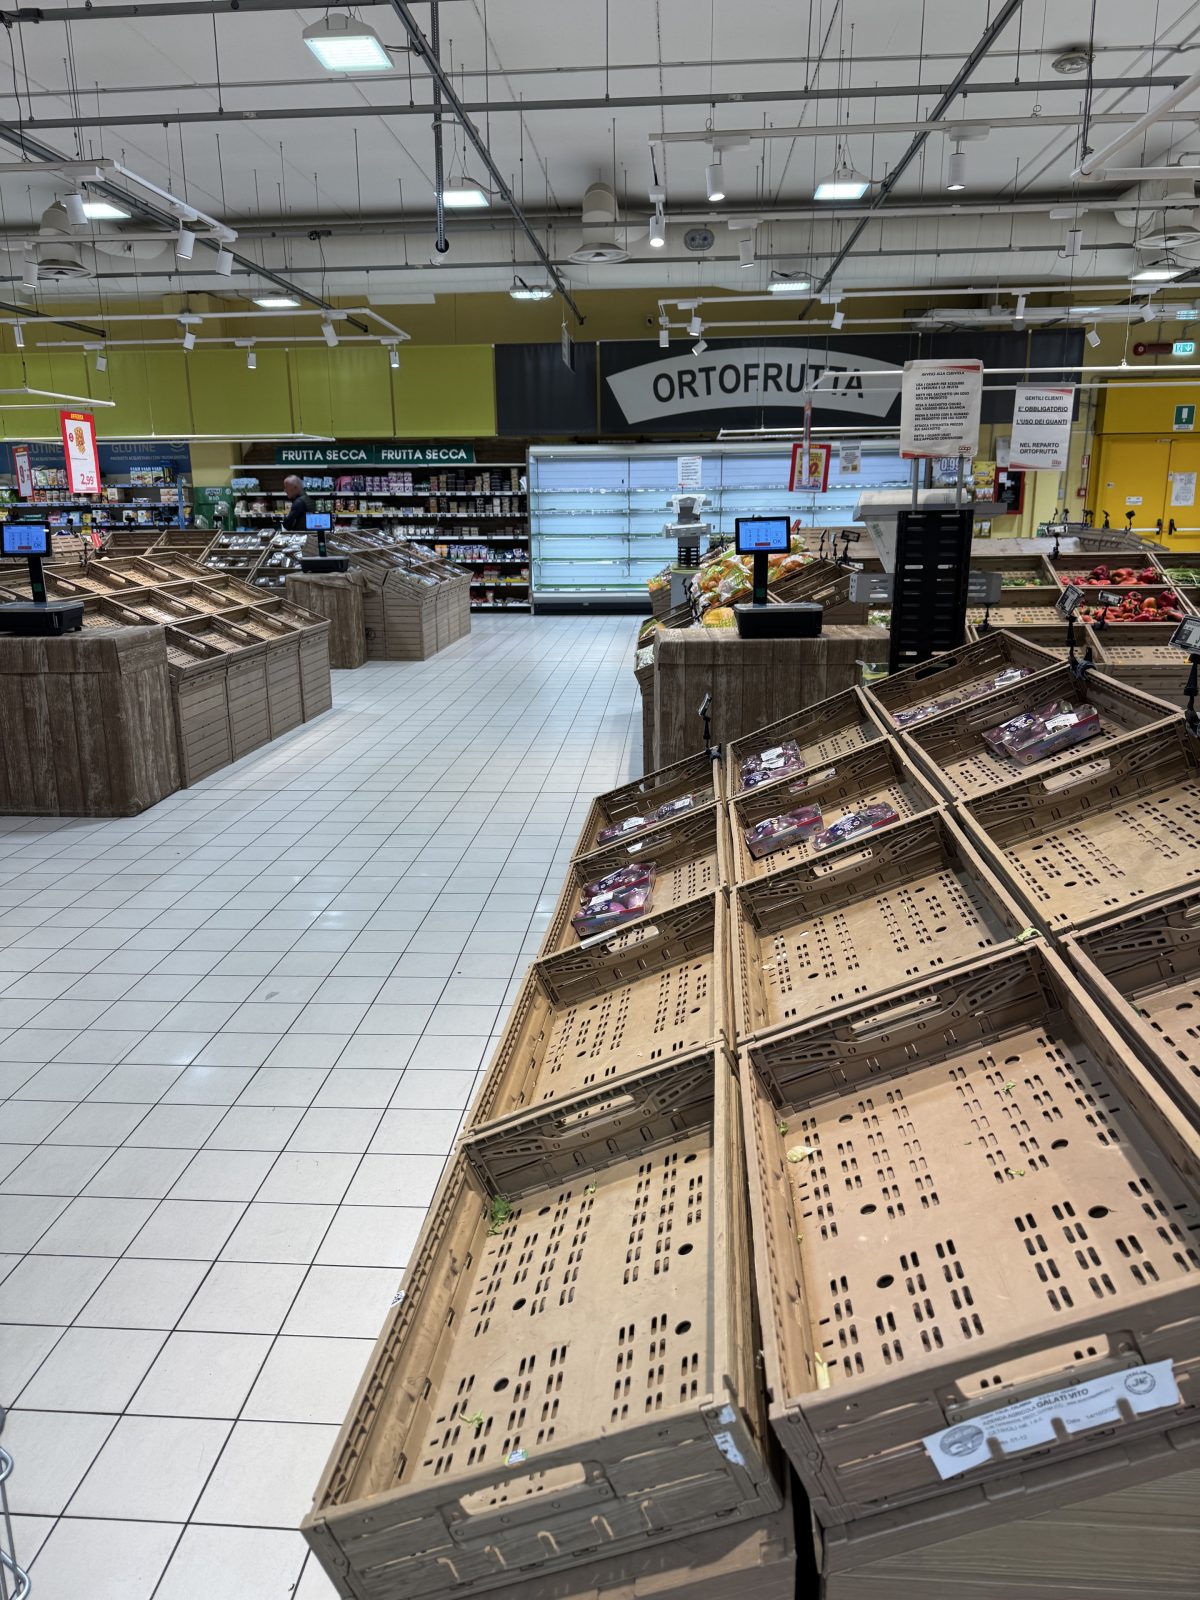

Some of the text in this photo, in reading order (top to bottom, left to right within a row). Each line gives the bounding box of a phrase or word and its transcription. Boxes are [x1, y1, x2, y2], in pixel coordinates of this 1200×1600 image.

[652, 362, 864, 403] ORTOFRUTTA
[282, 450, 367, 461] FRUTTA SECCA
[382, 449, 467, 460] FRUTTA SECCA
[80, 474, 94, 485] 2,99
[1036, 1394, 1067, 1408] GALATI
[1069, 1388, 1088, 1400] VITO
